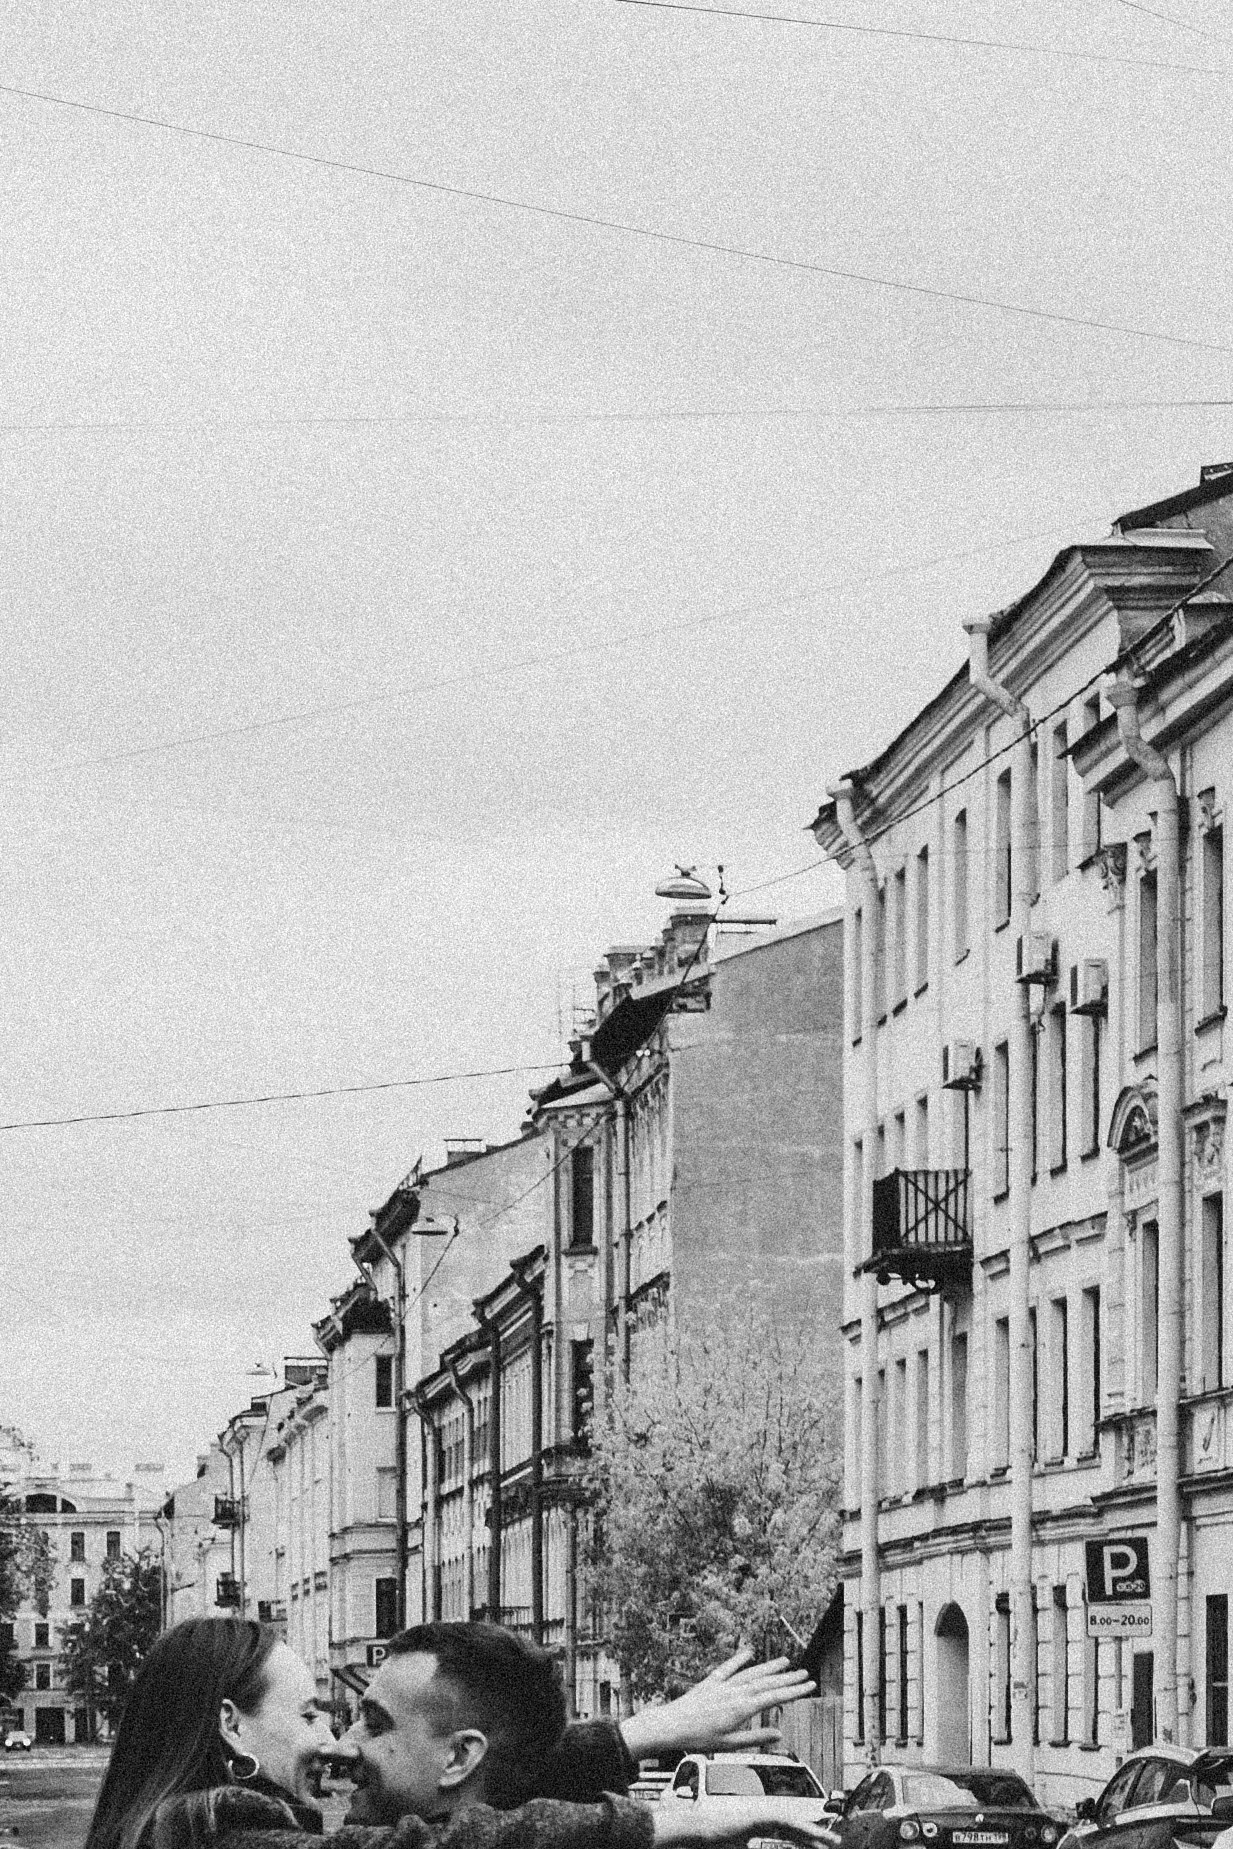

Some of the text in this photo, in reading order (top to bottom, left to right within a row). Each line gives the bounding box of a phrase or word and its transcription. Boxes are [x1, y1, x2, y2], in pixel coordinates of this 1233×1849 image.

[1103, 1545, 1138, 1596] P
[1089, 1614, 1150, 1626] 8.00-20.00
[372, 1646, 386, 1665] P
